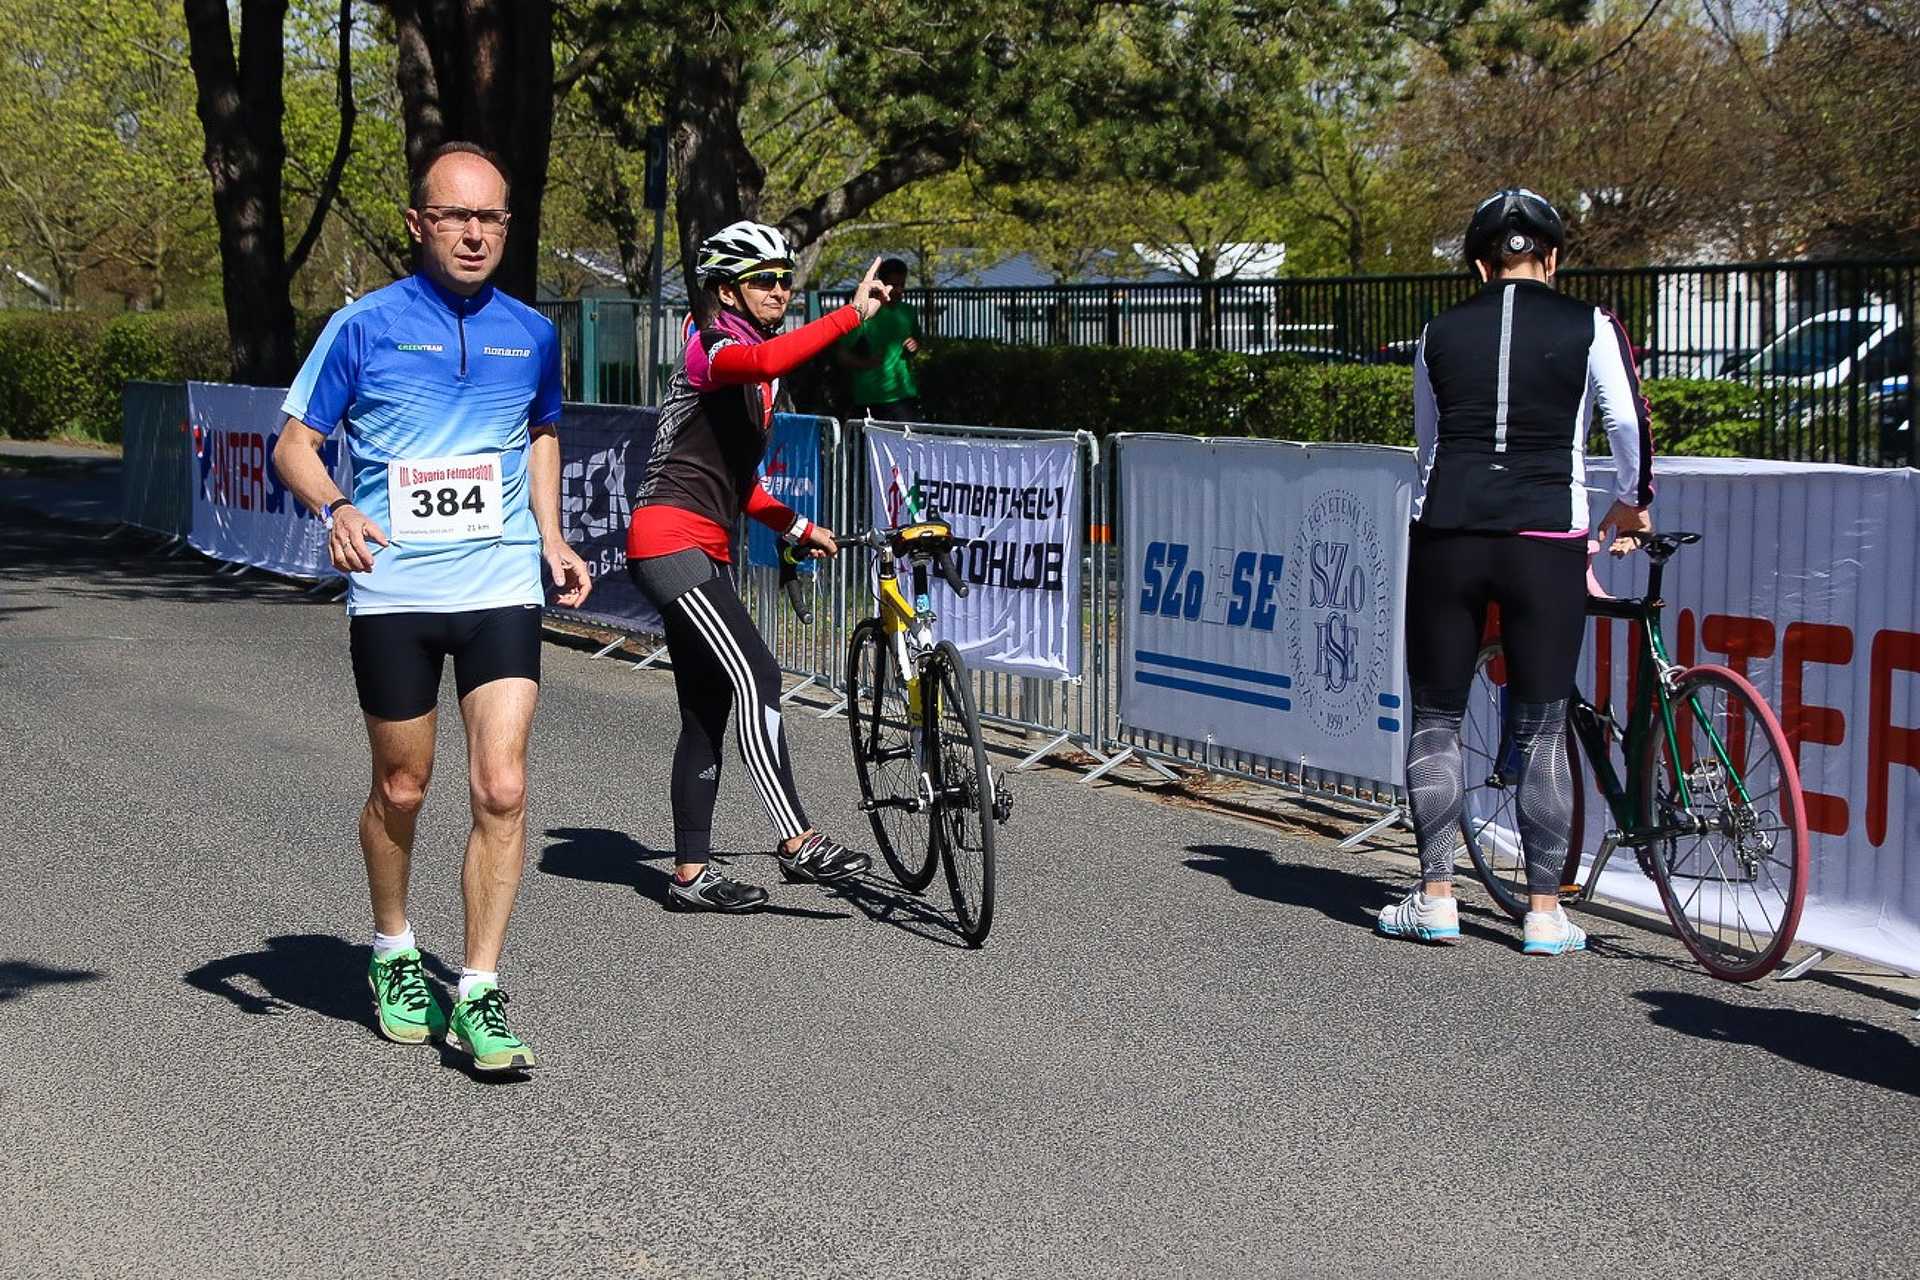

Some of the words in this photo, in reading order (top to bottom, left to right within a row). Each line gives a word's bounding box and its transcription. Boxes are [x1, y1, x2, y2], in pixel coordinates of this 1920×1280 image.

[484, 346, 531, 358] noname
[412, 468, 445, 486] Savaria
[411, 485, 485, 518] 384
